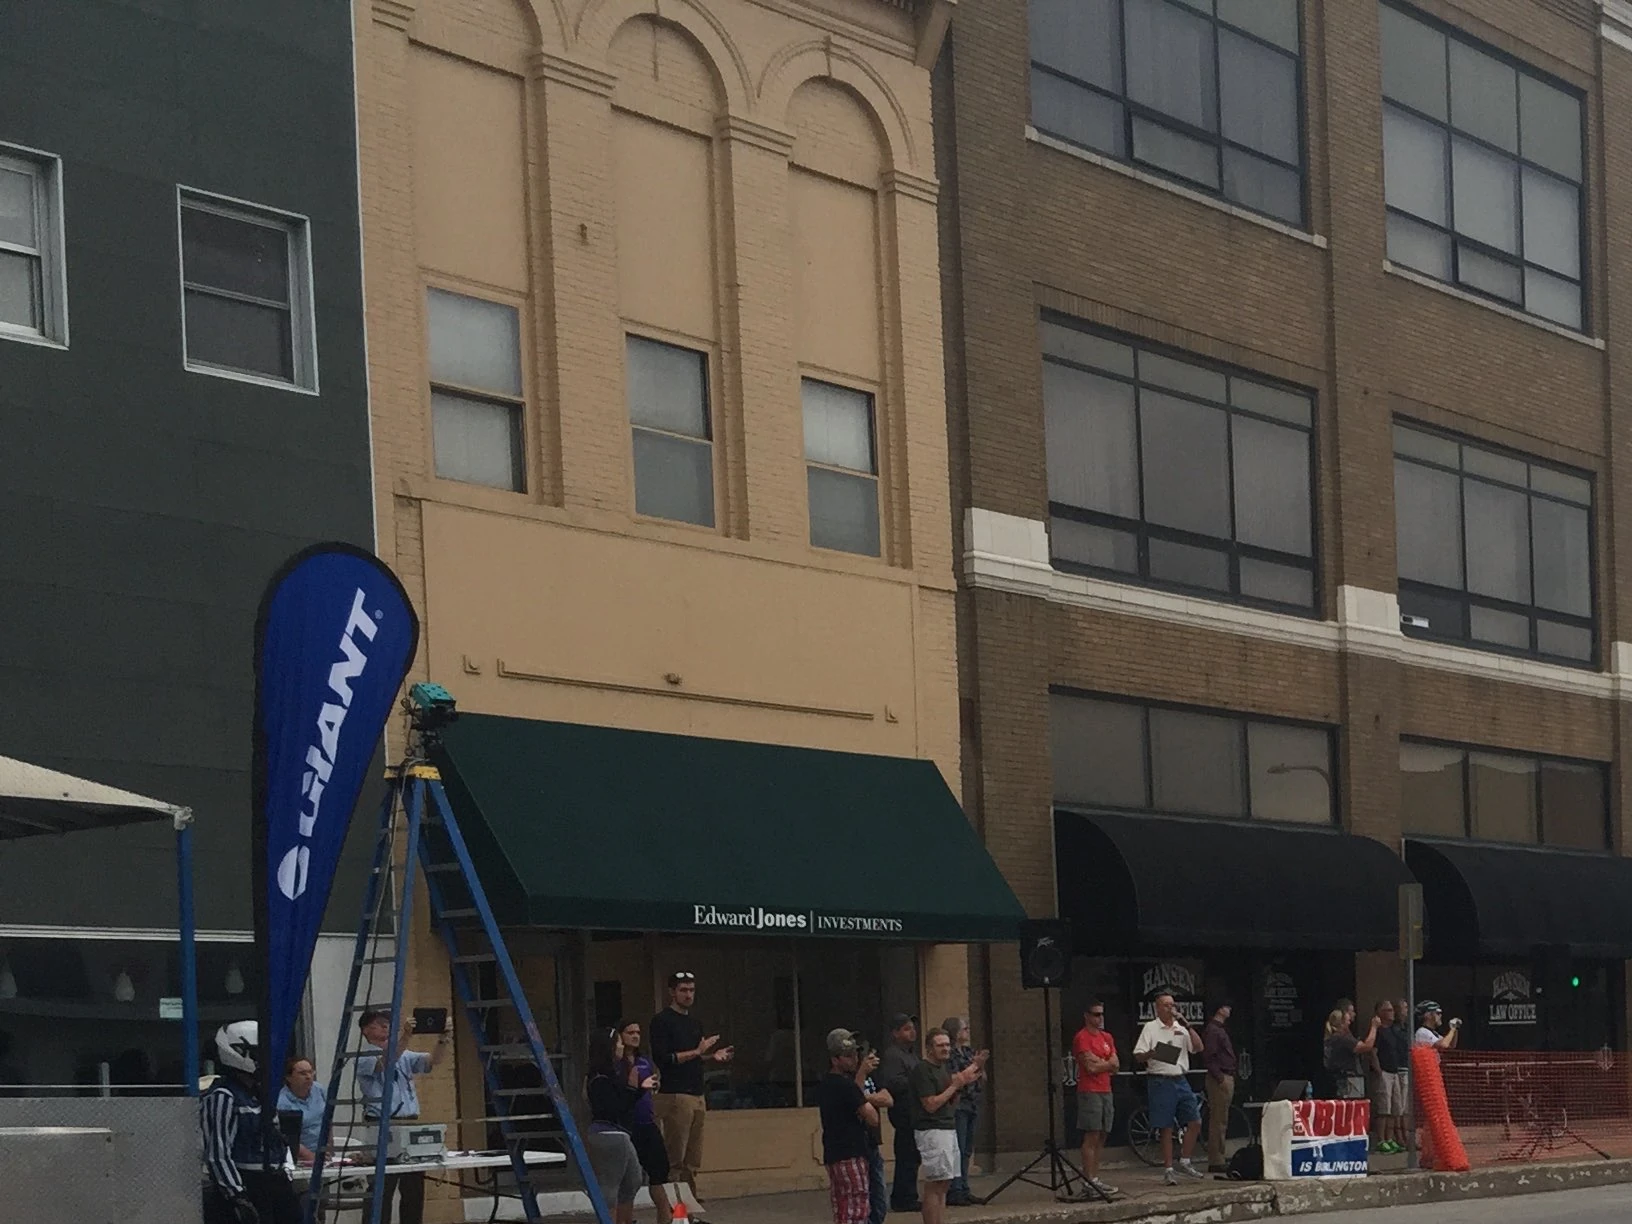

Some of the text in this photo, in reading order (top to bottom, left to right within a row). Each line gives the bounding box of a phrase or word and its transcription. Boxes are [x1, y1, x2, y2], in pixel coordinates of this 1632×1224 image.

[299, 588, 378, 837] GIANT
[818, 915, 903, 932] INVESTMENTS
[1143, 963, 1195, 996] HANSEN
[1489, 1003, 1536, 1020] LAW OFFICE
[1300, 1160, 1313, 1172] IS
